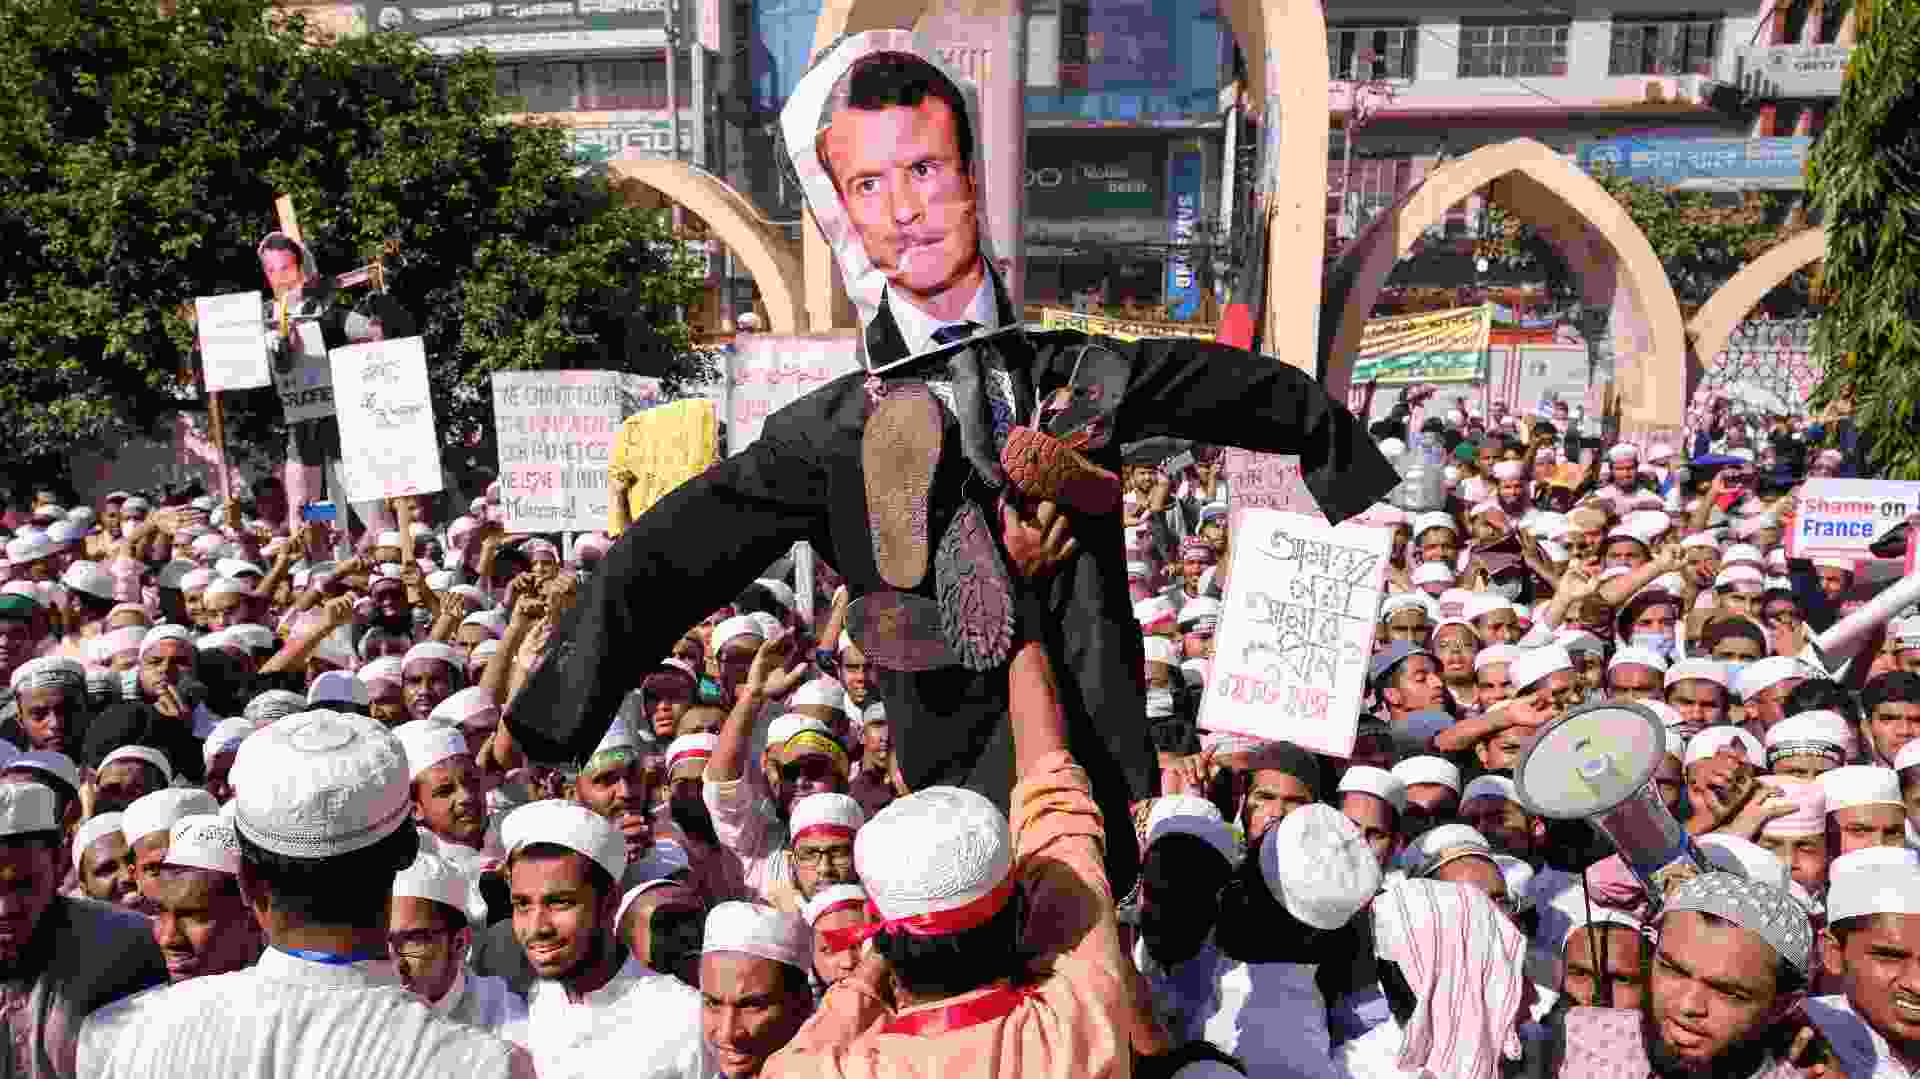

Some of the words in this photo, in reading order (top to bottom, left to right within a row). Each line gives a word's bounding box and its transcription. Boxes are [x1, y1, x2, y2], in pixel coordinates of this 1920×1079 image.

[1805, 496, 1875, 514] Shame
[1880, 501, 1907, 517] on
[1803, 518, 1874, 538] France
